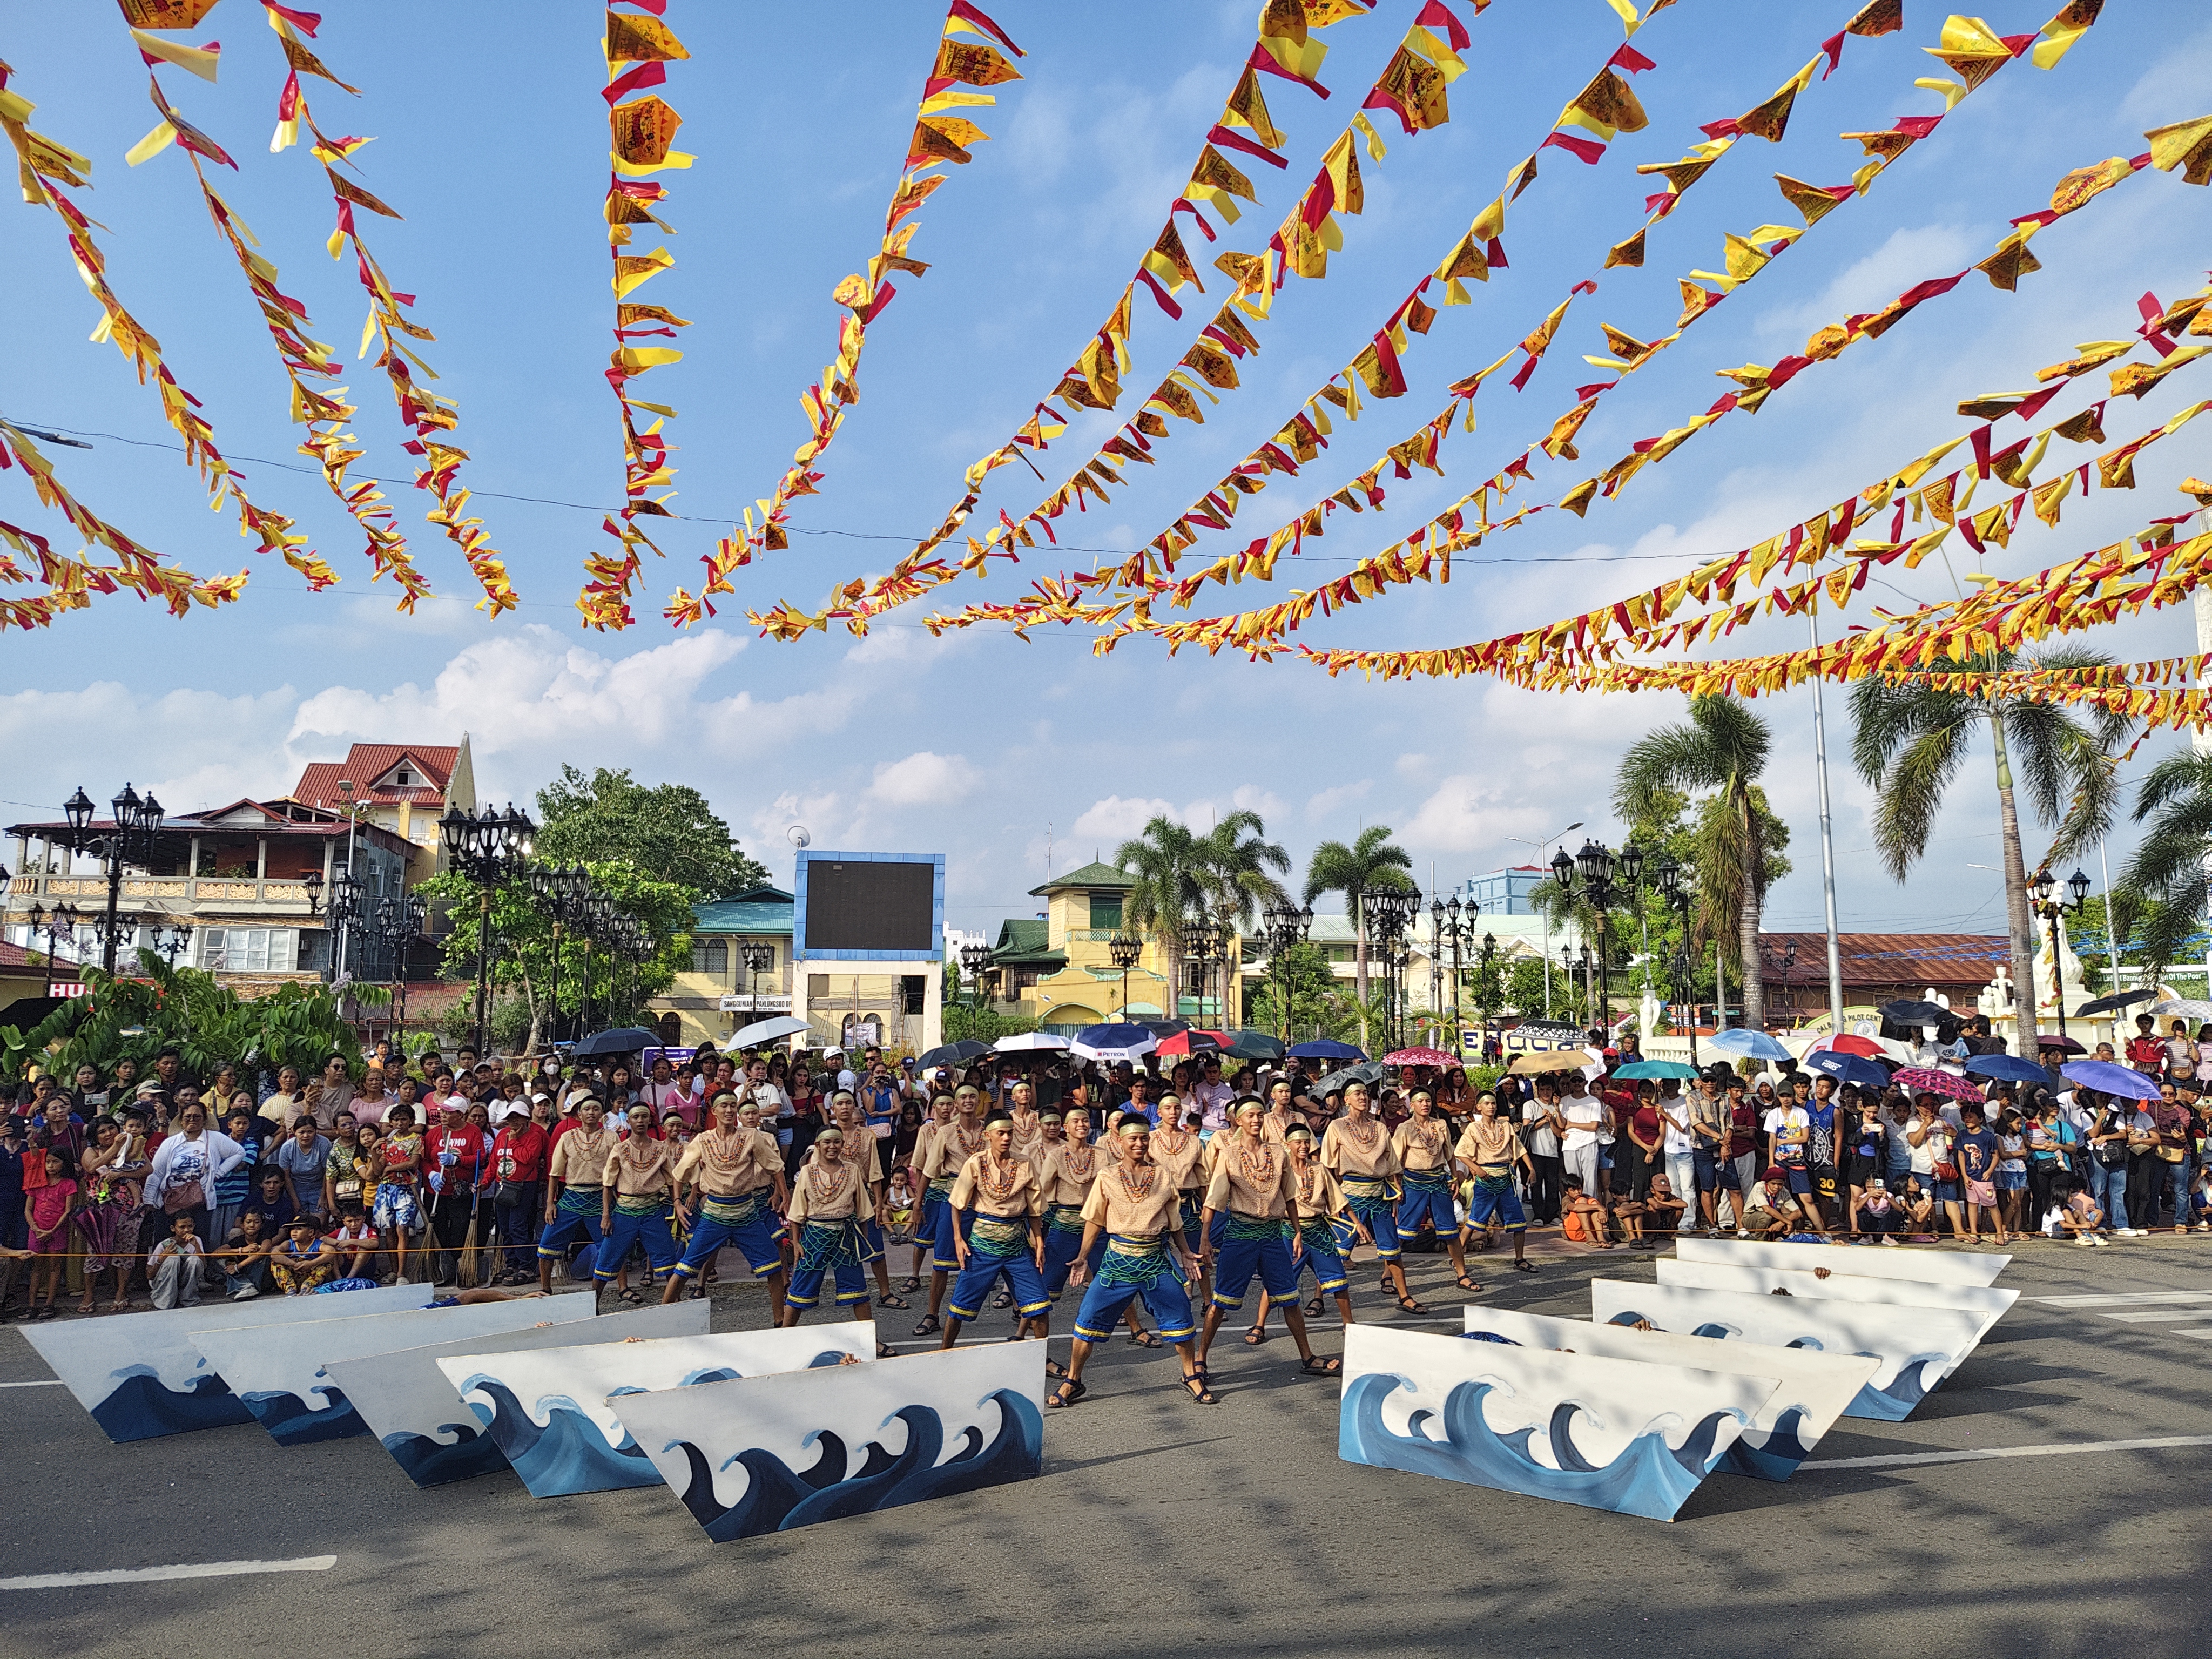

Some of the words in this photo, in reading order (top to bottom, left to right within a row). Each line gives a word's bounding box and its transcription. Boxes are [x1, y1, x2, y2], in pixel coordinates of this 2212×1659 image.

[2176, 973, 2187, 981] The
[1848, 1014, 1864, 1022] PILOT
[439, 1138, 467, 1147] CWMO
[1819, 1177, 1836, 1190] 30
